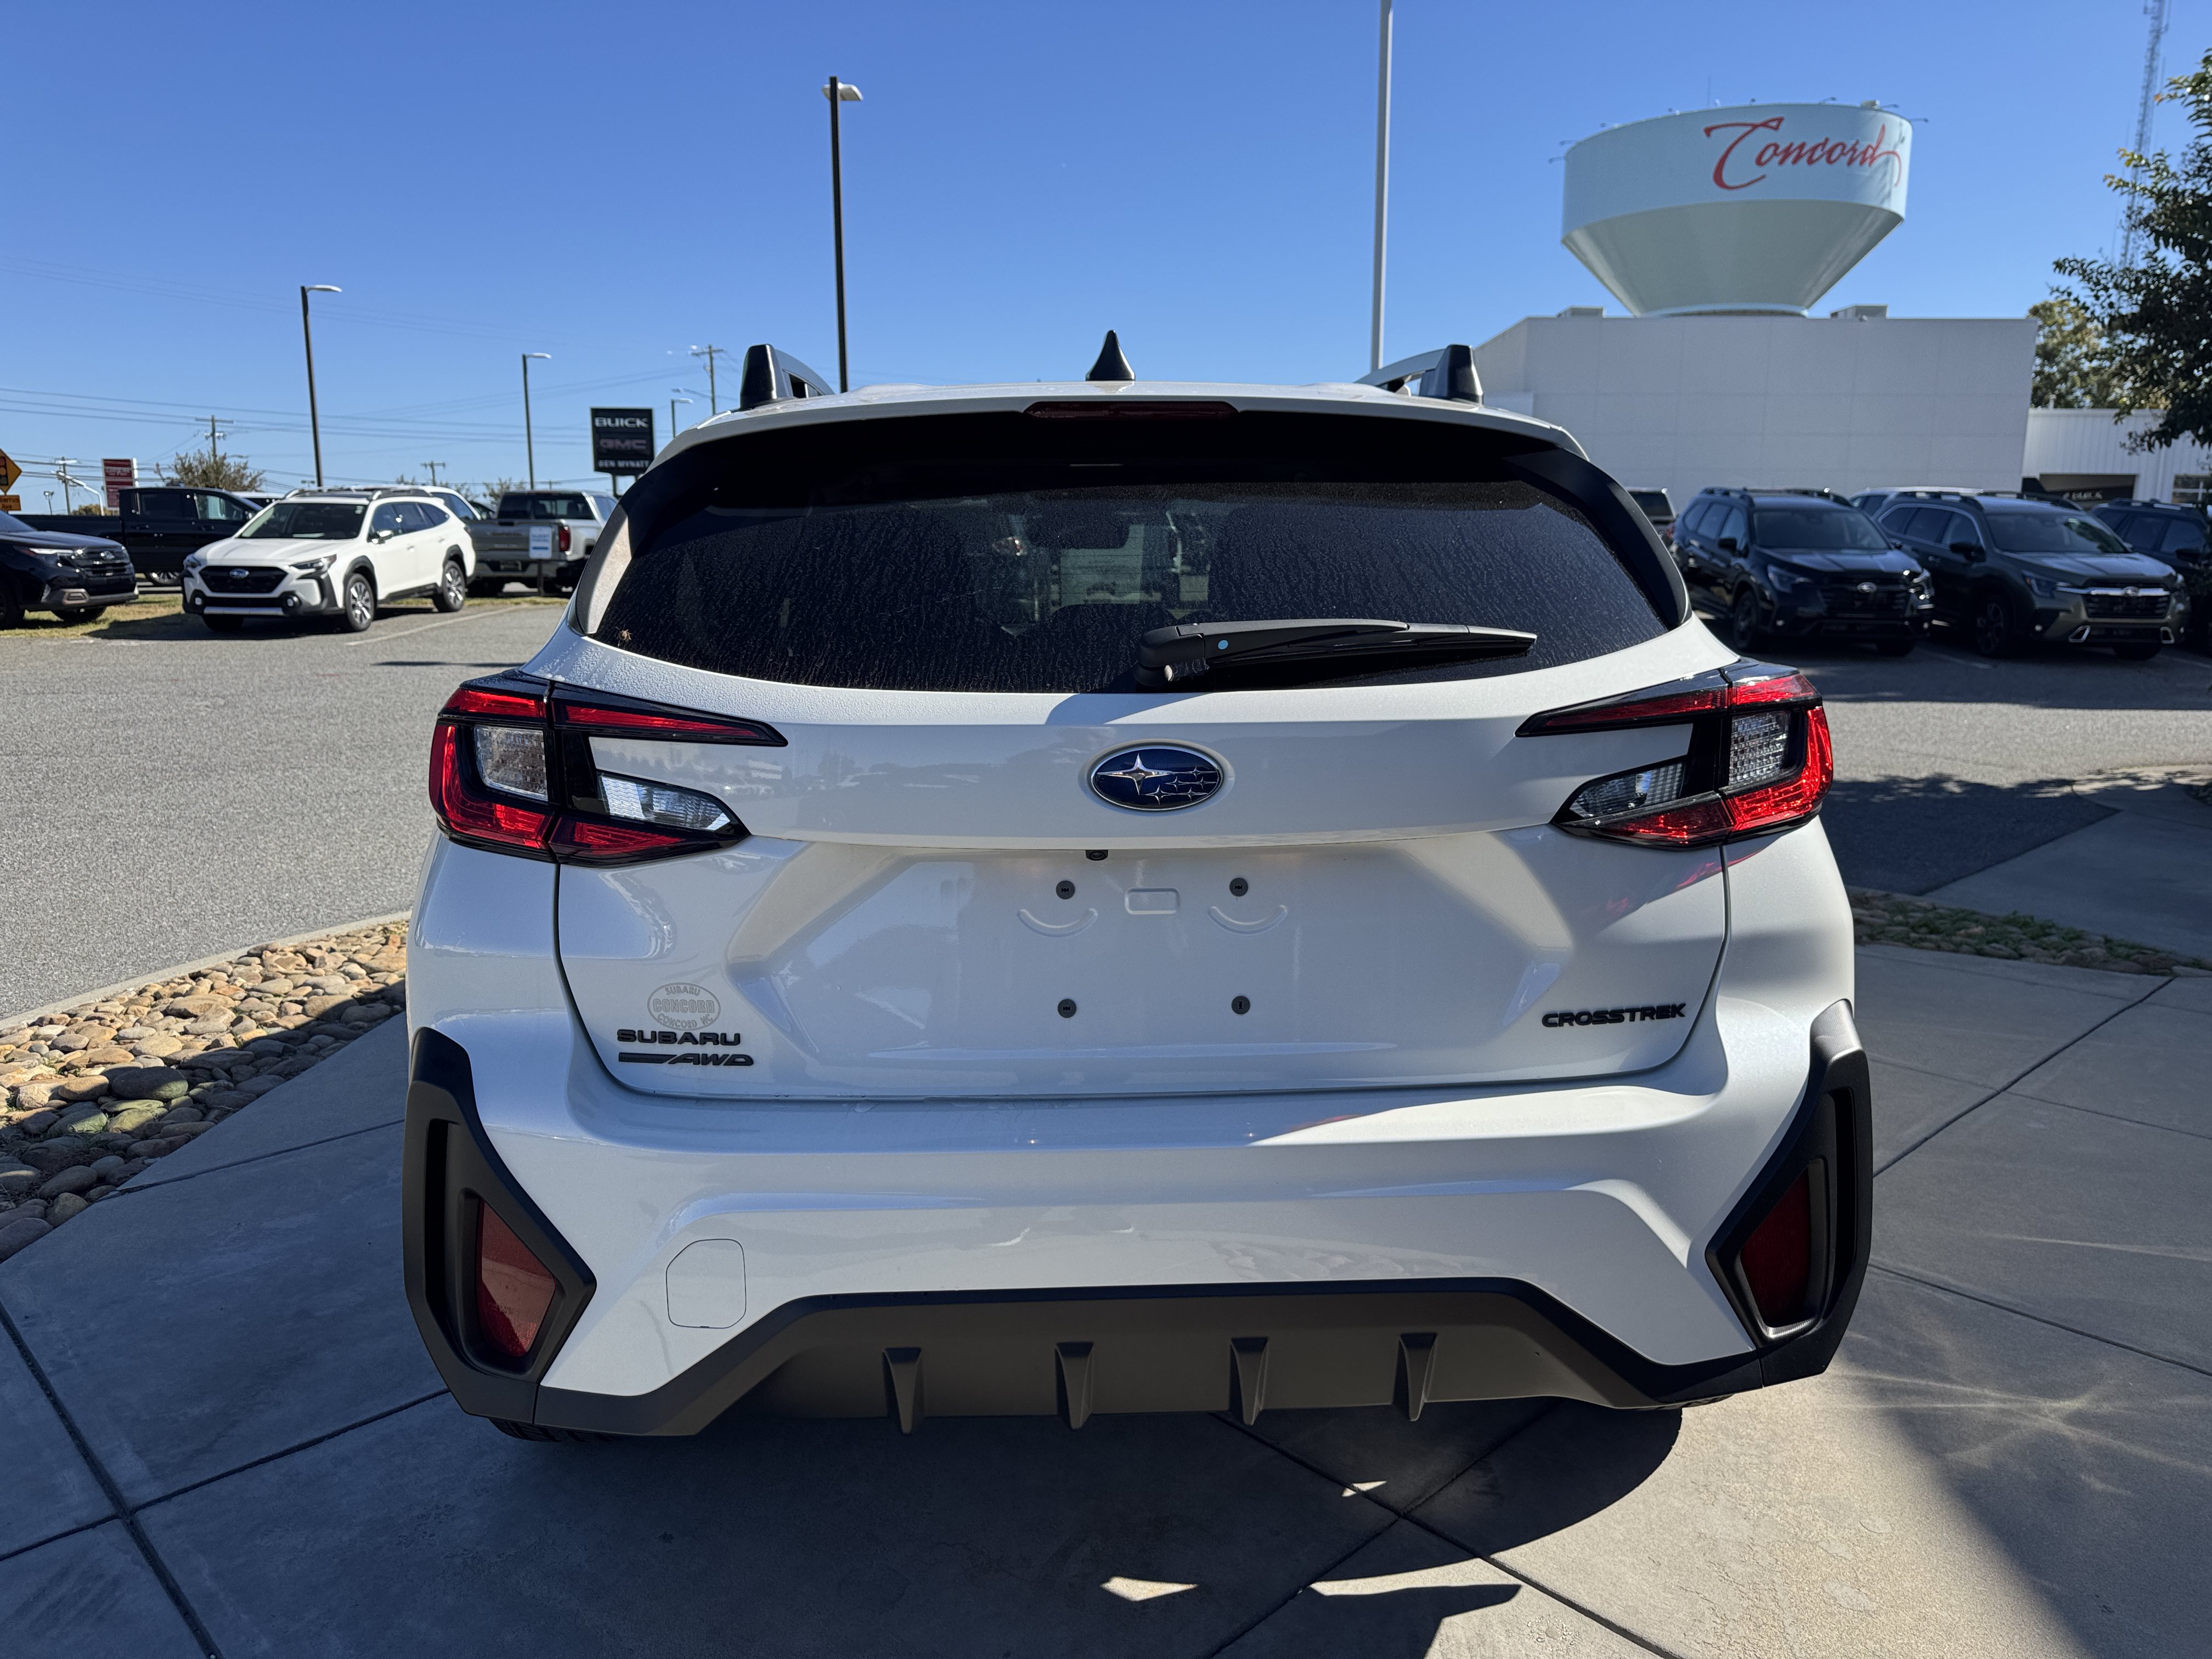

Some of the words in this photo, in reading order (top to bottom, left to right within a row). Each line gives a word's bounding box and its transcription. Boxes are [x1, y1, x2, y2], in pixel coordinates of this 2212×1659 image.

[1703, 116, 1901, 190] Concord
[595, 417, 648, 428] BUICK
[600, 439, 646, 449] GMC
[665, 986, 701, 996] SUBARU
[653, 998, 715, 1013] CONCORD
[658, 1013, 697, 1028] CONCORD
[700, 1014, 713, 1025] NC
[1542, 1003, 1686, 1028] CROSSTREK
[617, 1029, 741, 1046] SUBARU
[668, 1053, 754, 1066] AWD
